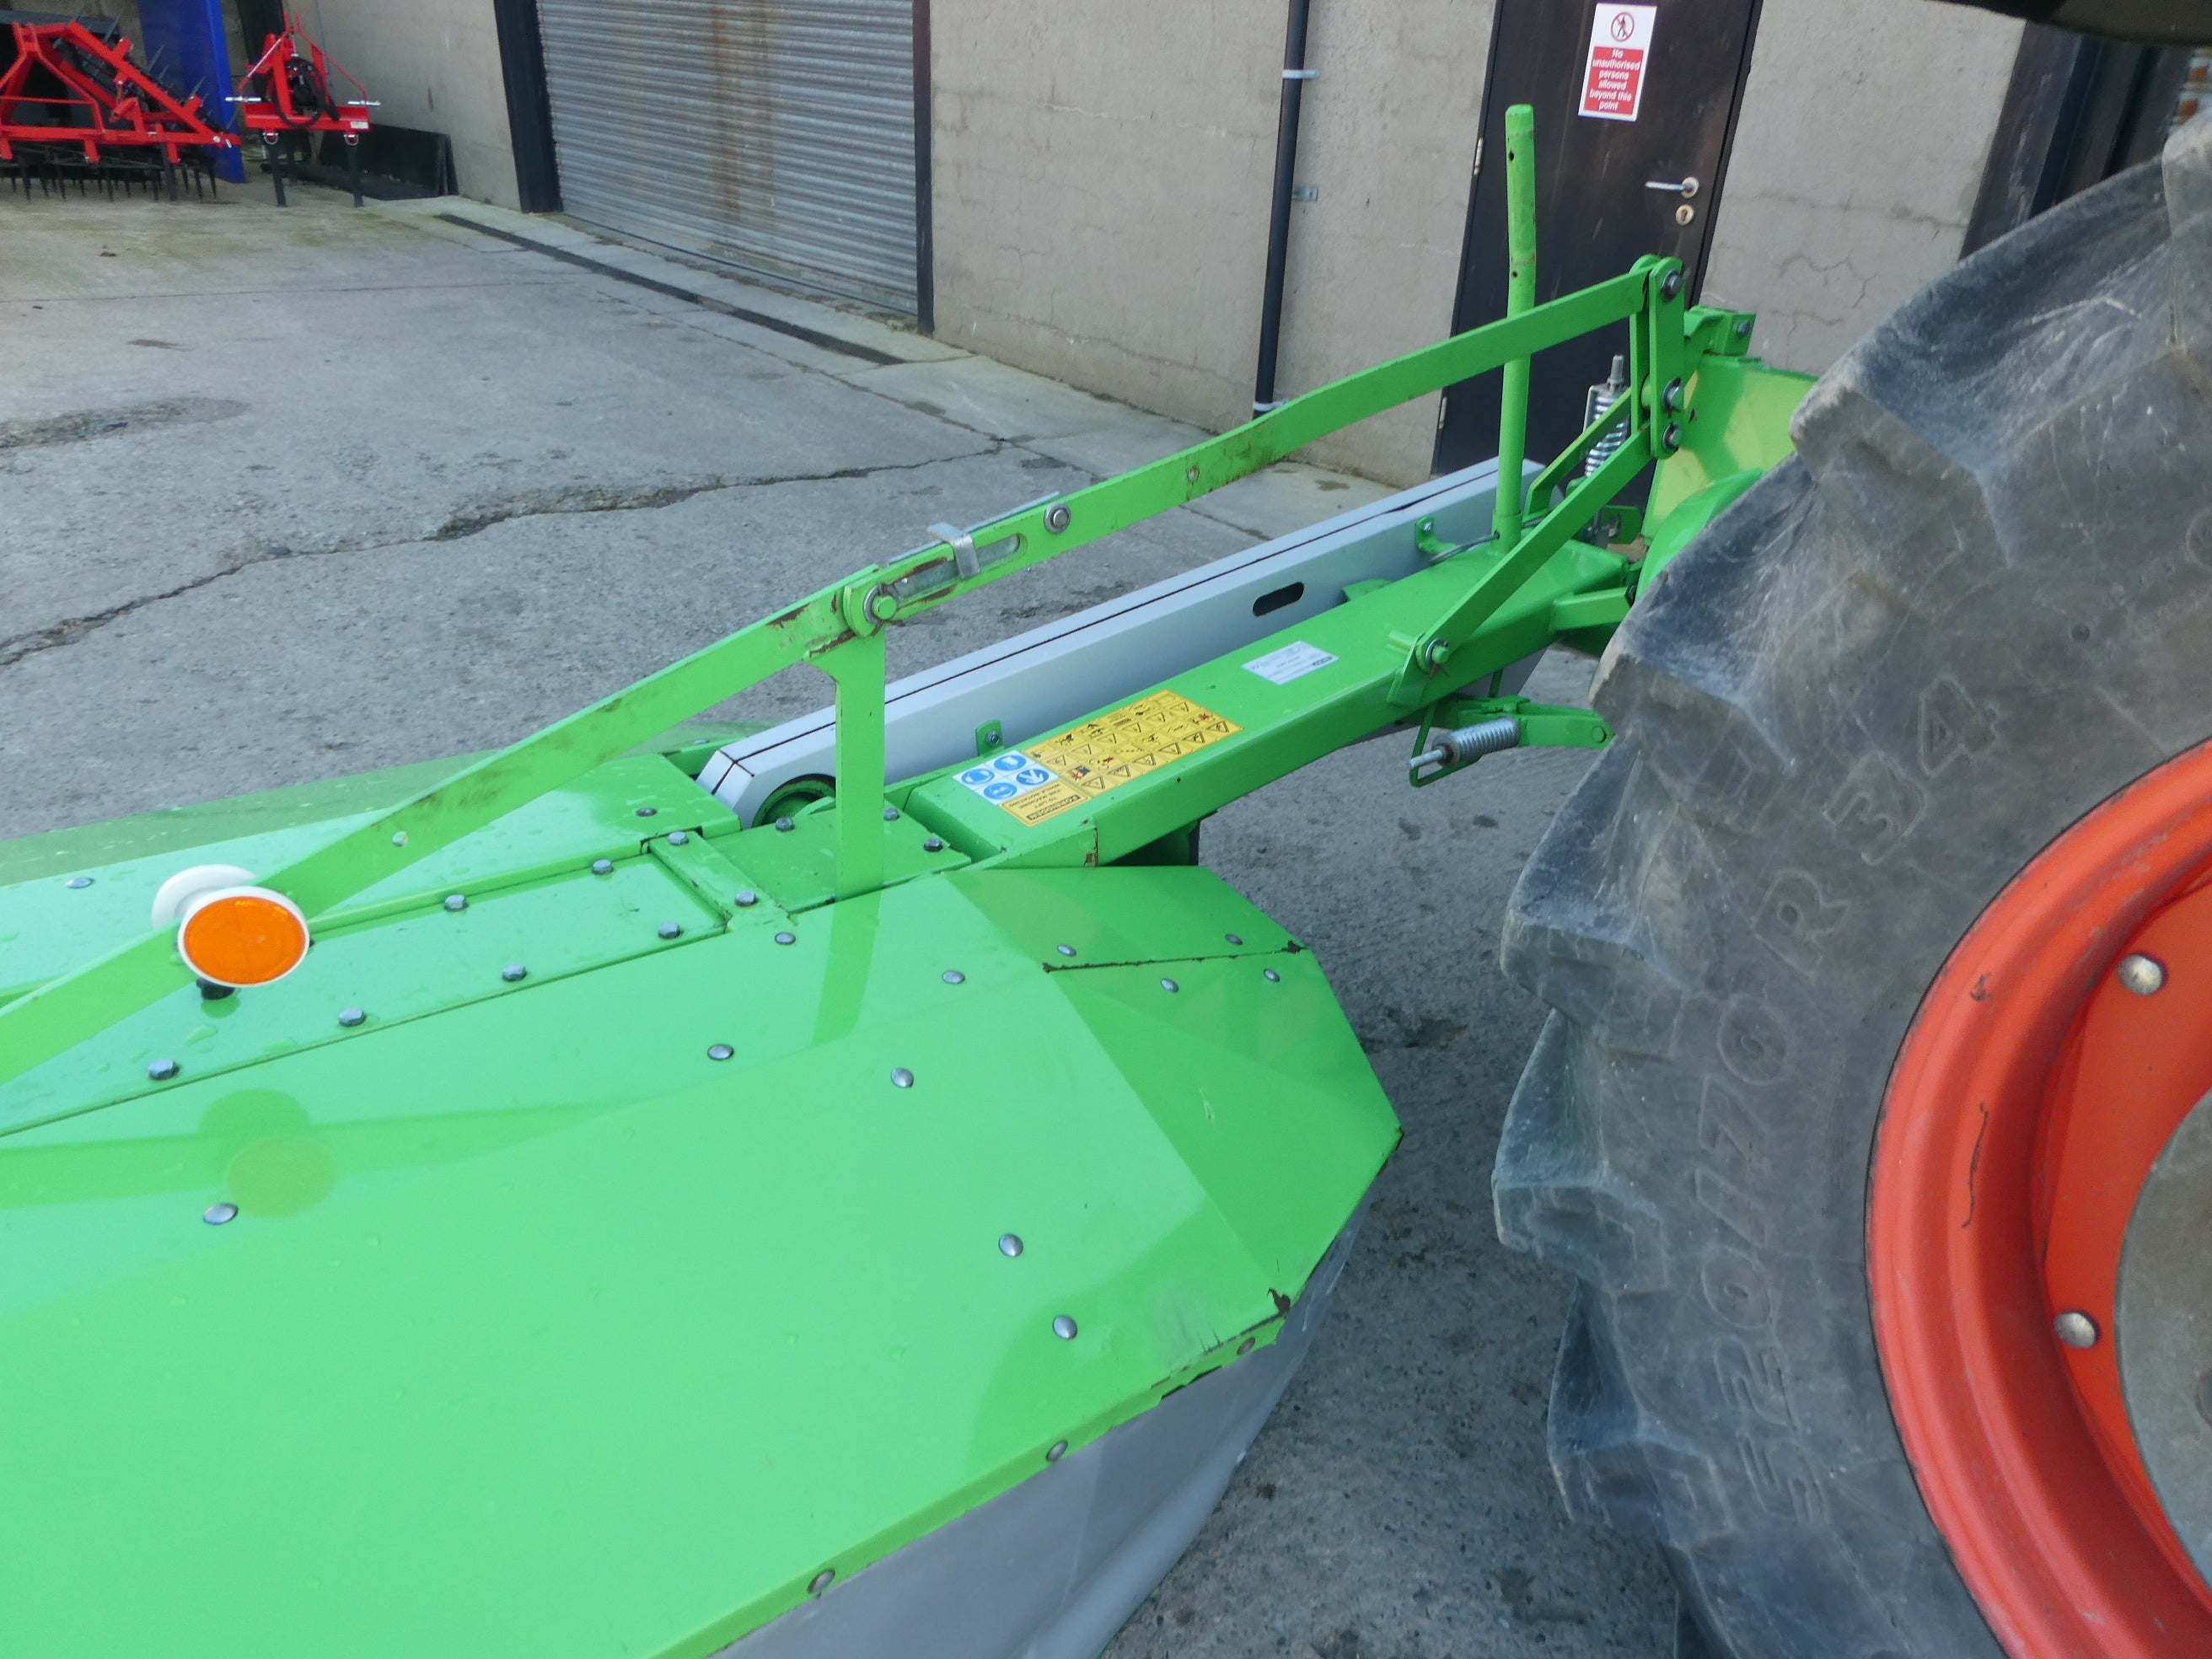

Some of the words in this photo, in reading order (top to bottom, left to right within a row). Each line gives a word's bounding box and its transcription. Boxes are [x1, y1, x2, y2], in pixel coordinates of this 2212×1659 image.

[1612, 48, 1624, 58] No
[1592, 59, 1640, 71] unauthorised
[1598, 70, 1629, 80] persons
[1598, 80, 1627, 90] allowed
[1589, 89, 1617, 100] beyond
[1618, 90, 1632, 101] this
[1598, 101, 1619, 110] point
